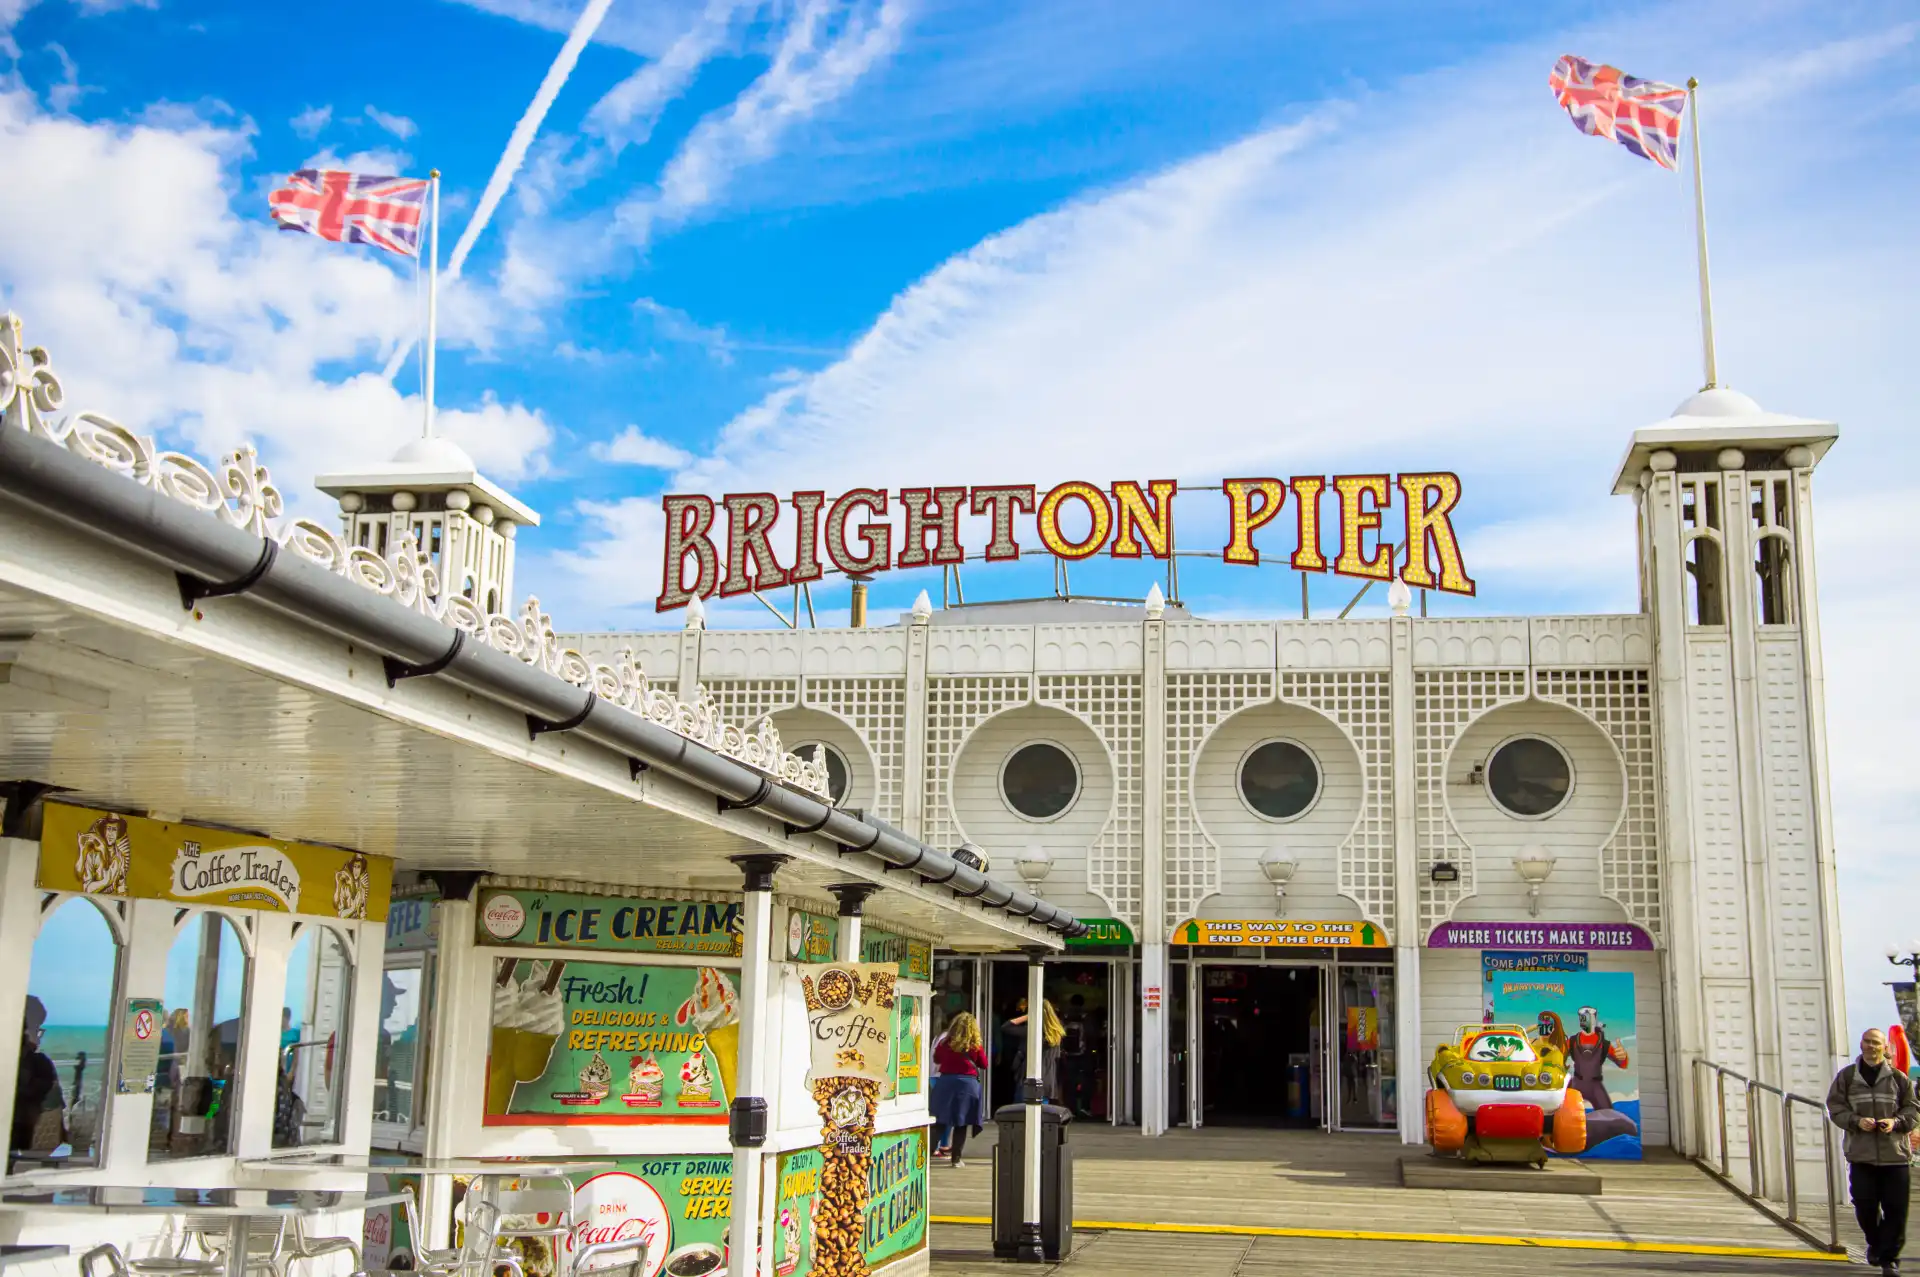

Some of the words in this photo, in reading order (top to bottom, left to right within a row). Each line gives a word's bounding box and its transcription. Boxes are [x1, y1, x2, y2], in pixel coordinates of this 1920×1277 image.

[655, 479, 1177, 613] BRIGHTON
[1223, 472, 1476, 597] PIER
[184, 840, 201, 858] THE
[180, 854, 241, 891] Coffee
[240, 851, 296, 900] Trader
[536, 909, 601, 946] ICE
[1087, 924, 1120, 939] FUN
[1205, 922, 1242, 931] THIS
[1247, 923, 1288, 931] WAY
[1292, 923, 1317, 932] TO
[1322, 924, 1354, 932] THE
[656, 940, 687, 950] RELAX
[688, 942, 695, 950] &
[1208, 935, 1243, 943] END
[1249, 935, 1272, 943] OF
[1276, 936, 1308, 944] THE
[1312, 936, 1351, 944] PIER
[1448, 930, 1490, 944] WHERE
[1495, 930, 1544, 944] TICKETS
[1550, 930, 1585, 945] MAKE
[1590, 931, 1633, 945] PRIZES
[1484, 956, 1514, 969] COME
[1516, 956, 1538, 967] AND
[1541, 954, 1560, 964] TRY
[1563, 953, 1585, 966] OUR
[563, 973, 649, 1004] Fresh!
[571, 1010, 657, 1027] DELICIOUS
[660, 1014, 669, 1025] &
[811, 1012, 887, 1048] Coffee
[569, 1030, 706, 1053] REFRESHING
[827, 1131, 858, 1143] Coffee
[839, 1142, 869, 1154] Trader
[641, 1161, 681, 1176] SOFT
[685, 1161, 733, 1175] DRINK
[792, 1154, 808, 1171] ENJOY
[869, 1138, 910, 1202] COFFEE
[784, 1168, 817, 1201] SUNDAE
[600, 1204, 627, 1214] DRINK
[863, 1201, 885, 1257] ICE
[888, 1173, 923, 1237] CREAM
